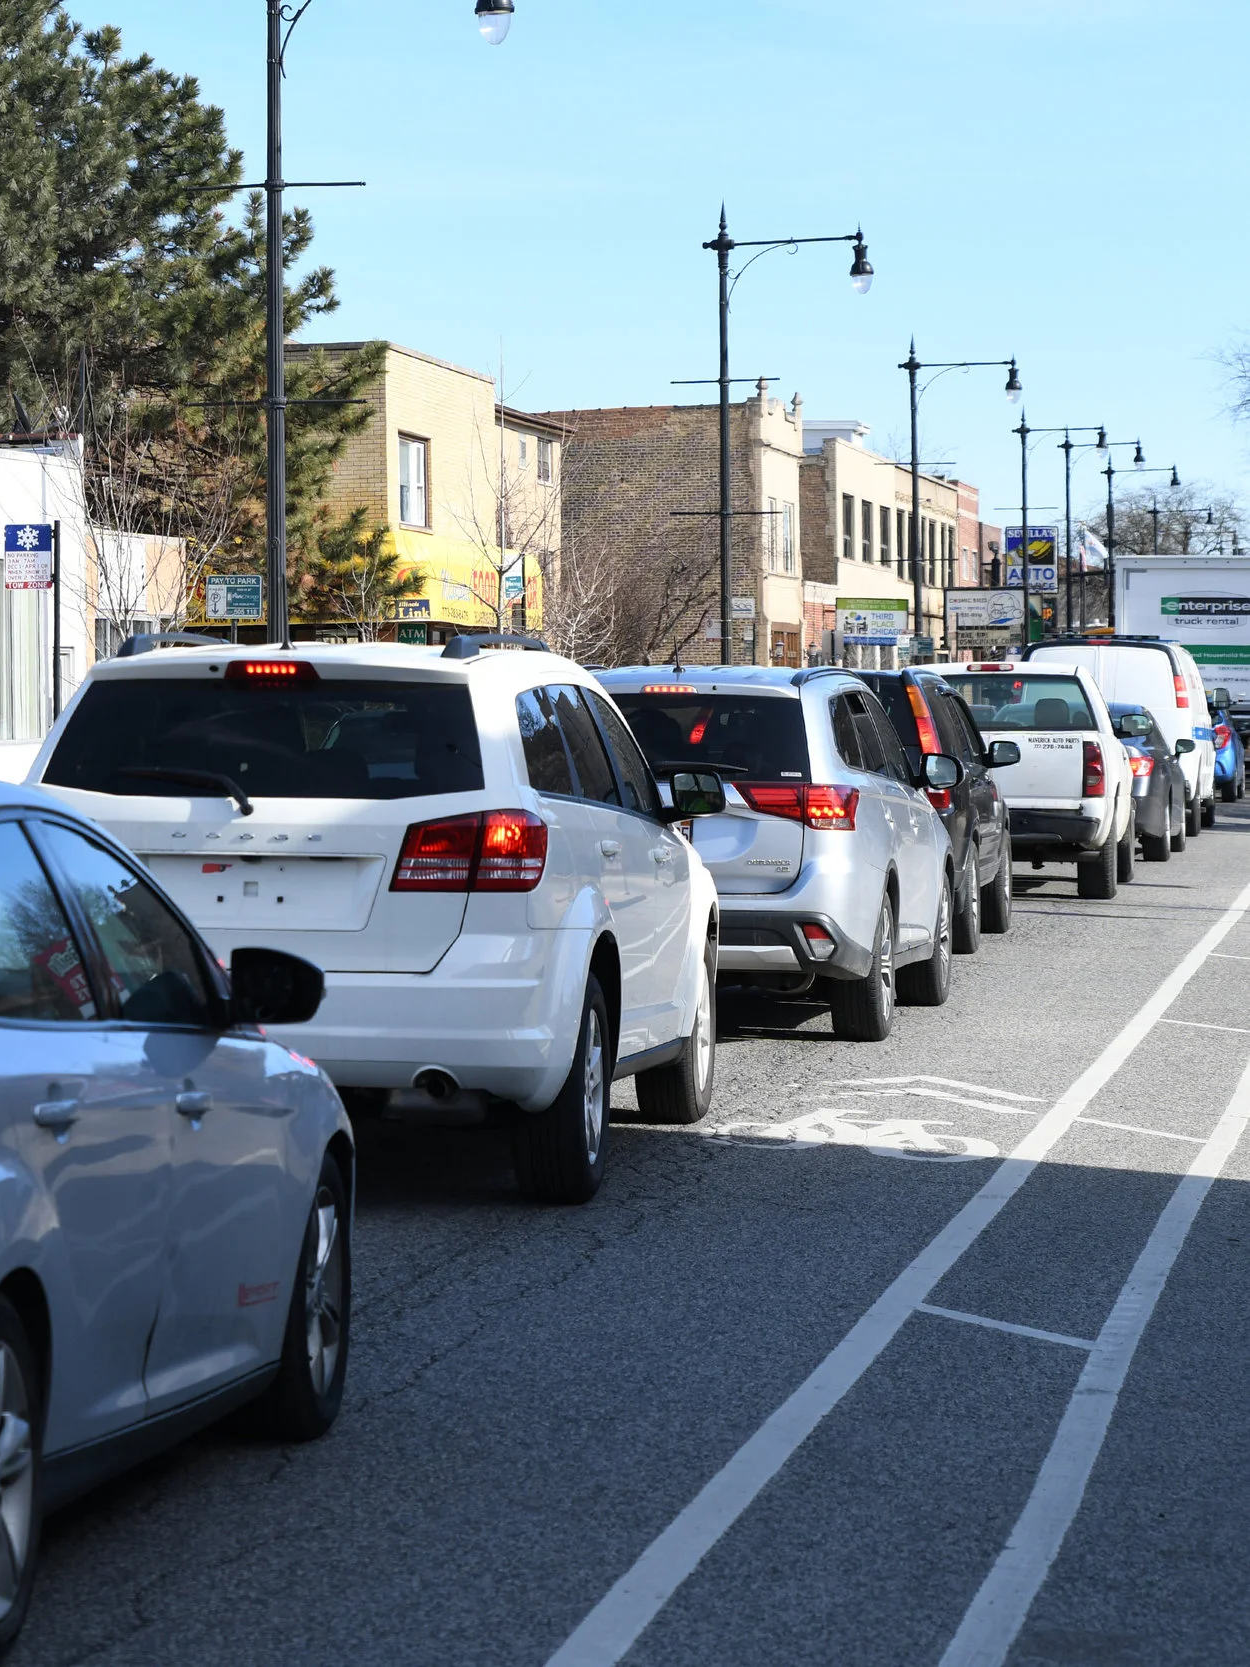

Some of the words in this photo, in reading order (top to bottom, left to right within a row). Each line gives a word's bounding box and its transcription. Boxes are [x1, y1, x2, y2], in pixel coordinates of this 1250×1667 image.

[1009, 568, 1054, 580] AUTO
[472, 570, 496, 606] FOOD
[398, 607, 430, 618] Link
[1165, 601, 1250, 613] enterprise
[1207, 617, 1239, 625] rental
[399, 629, 424, 638] ATM
